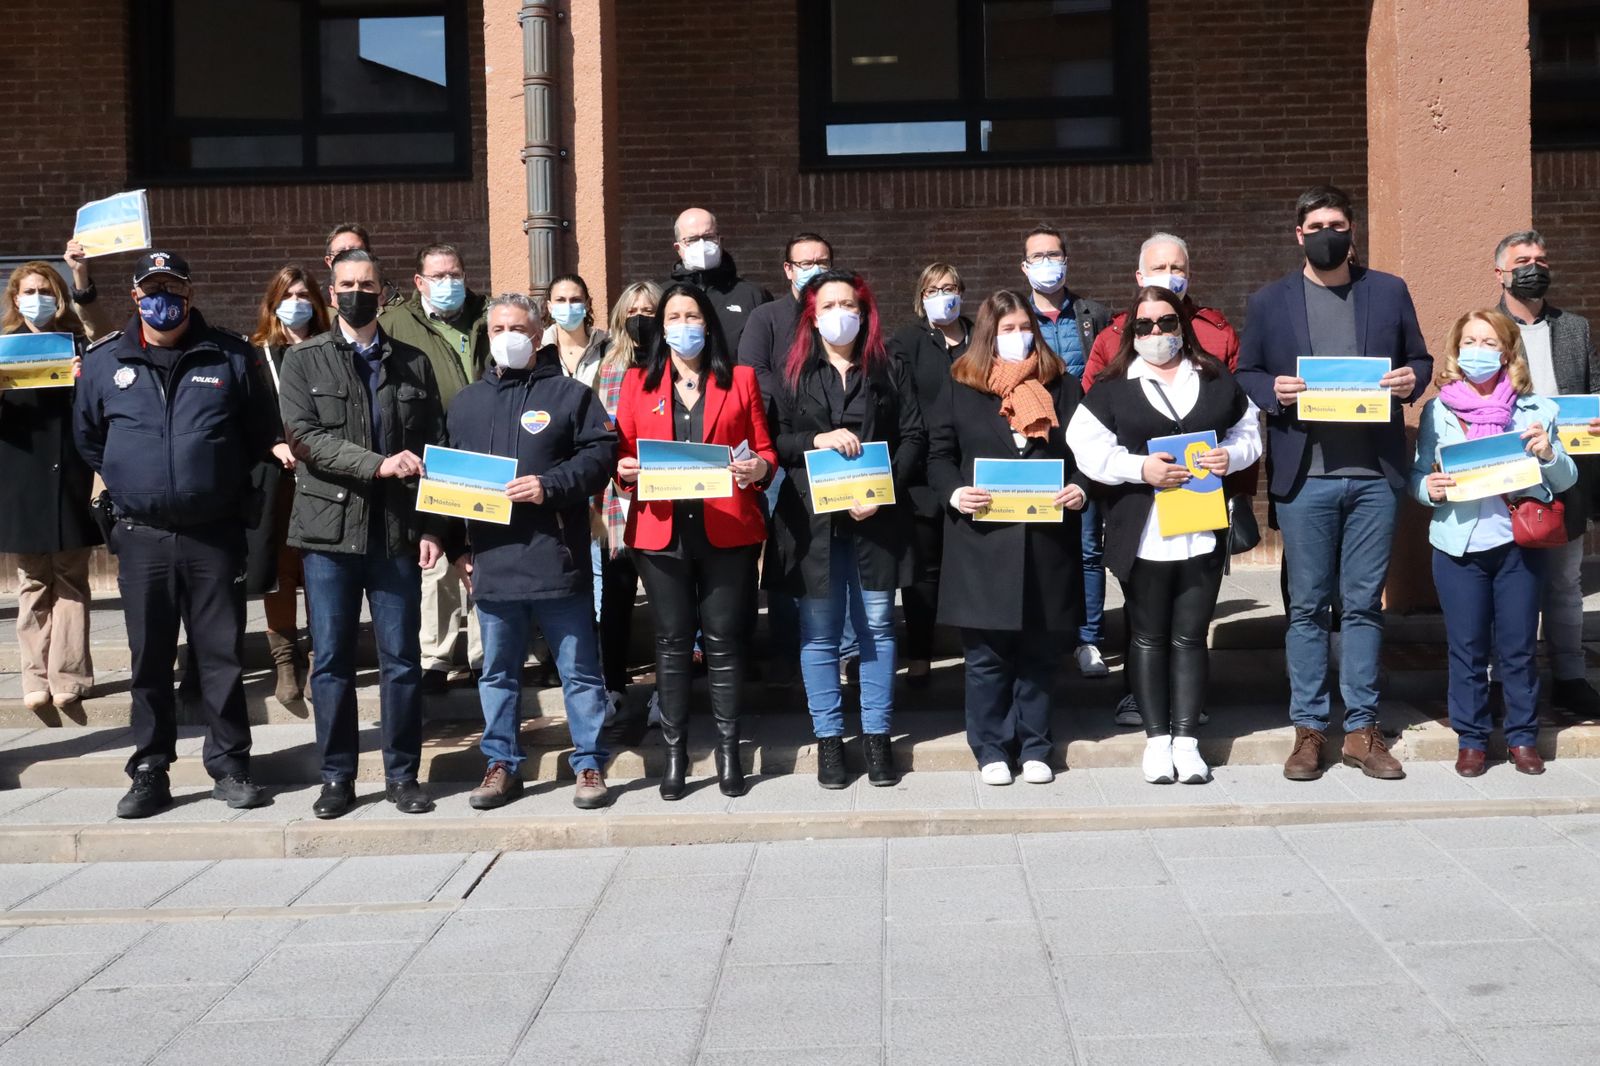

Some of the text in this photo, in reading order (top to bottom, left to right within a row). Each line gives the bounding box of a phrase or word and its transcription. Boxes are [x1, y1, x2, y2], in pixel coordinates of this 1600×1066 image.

[191, 375, 220, 384] POLICÍA
[852, 471, 869, 479] pueblo
[465, 482, 482, 490] pueblo
[432, 497, 462, 508] Móstoles
[827, 495, 854, 503] Móstoles
[989, 505, 1015, 513] Móstoles
